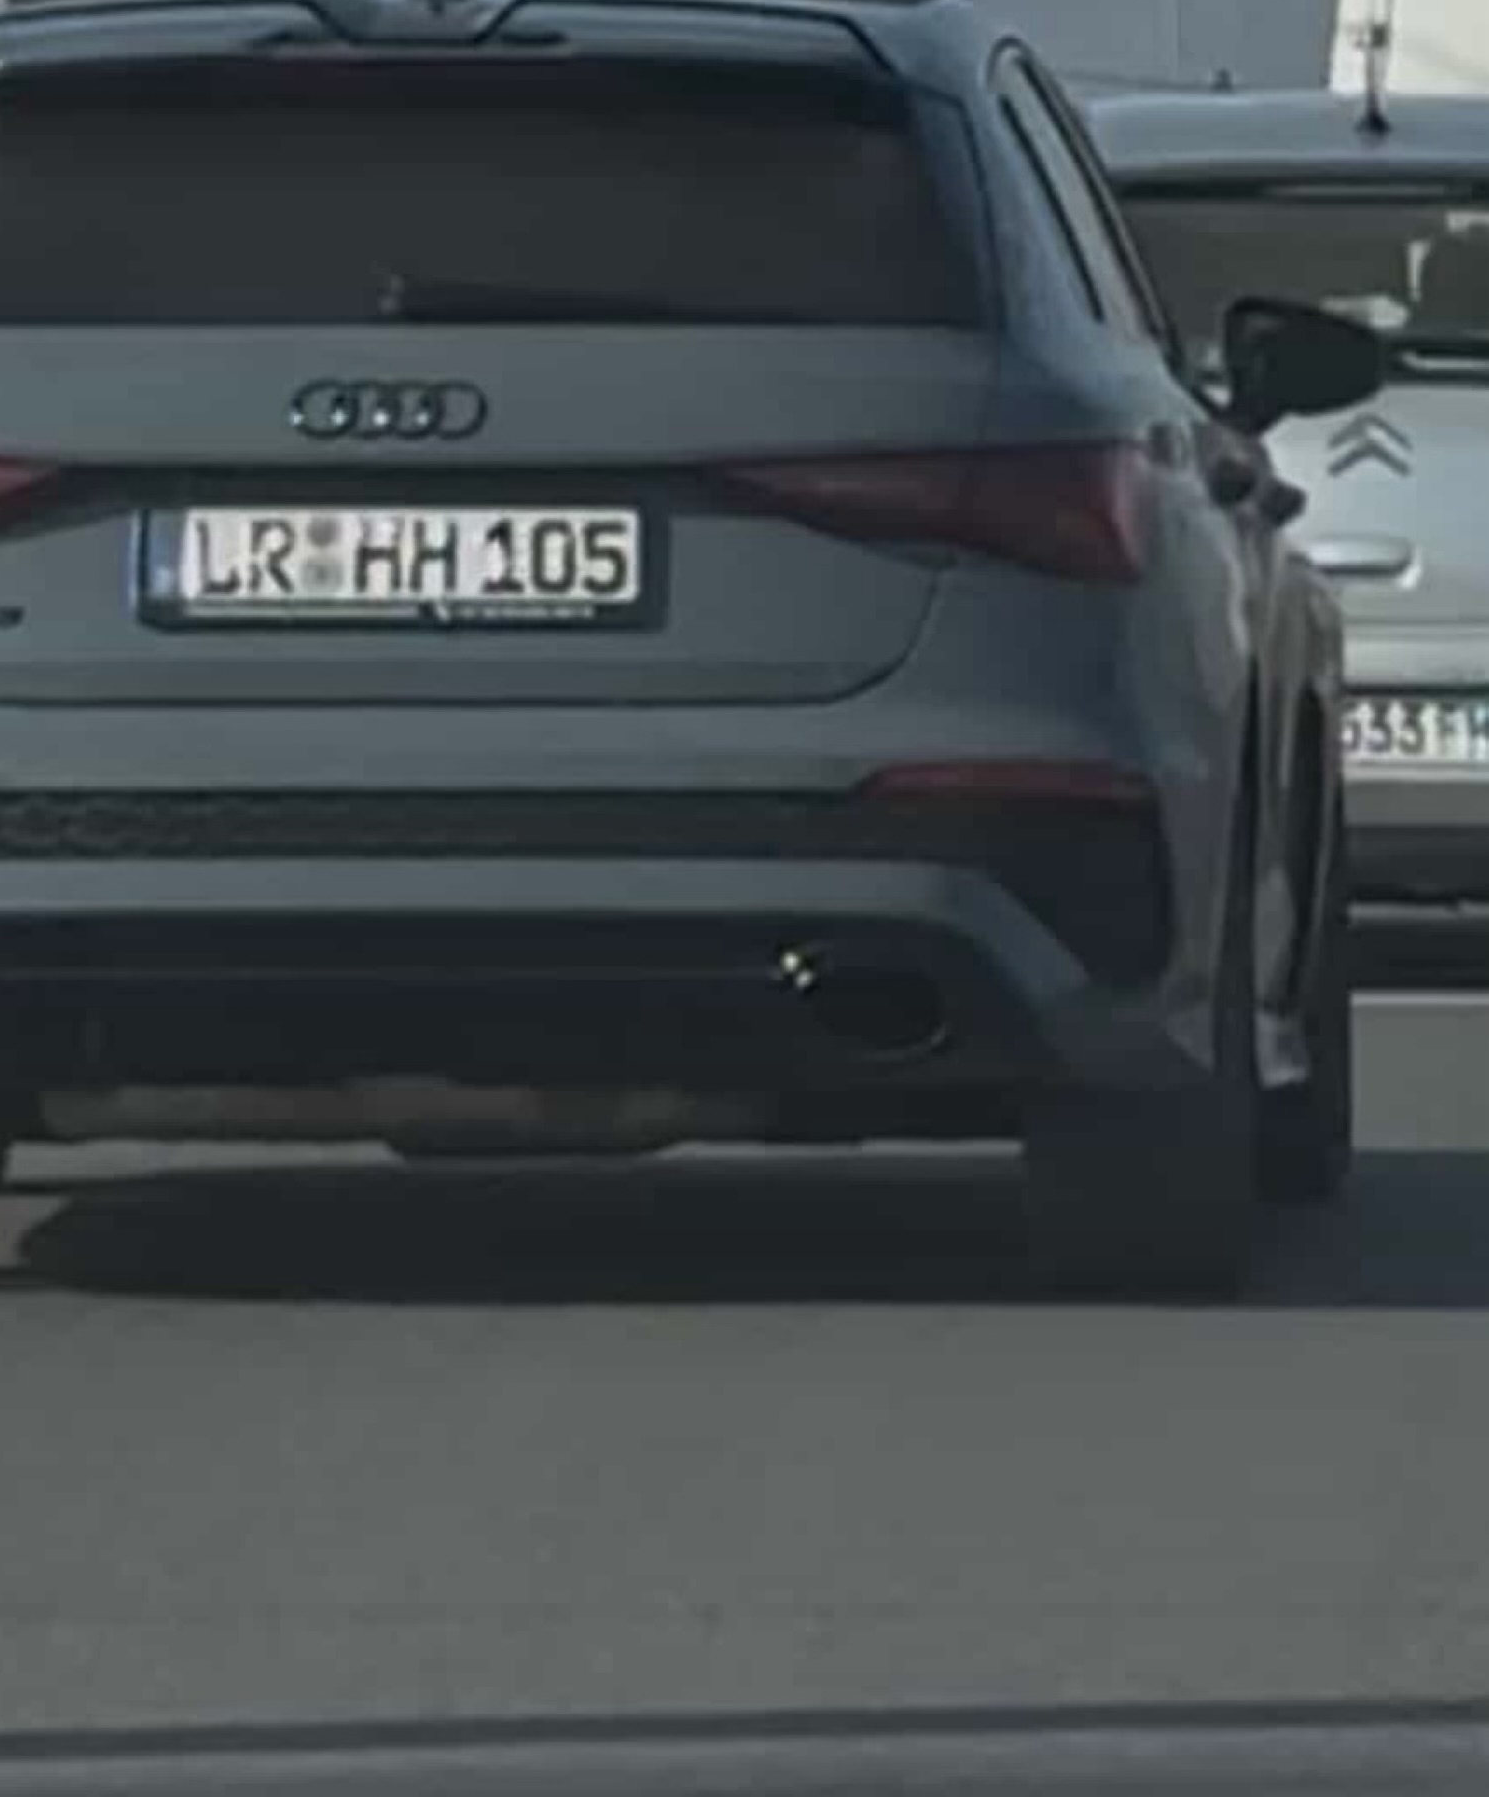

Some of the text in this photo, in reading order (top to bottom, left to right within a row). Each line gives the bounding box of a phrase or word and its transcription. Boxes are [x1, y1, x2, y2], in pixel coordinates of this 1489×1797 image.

[196, 520, 295, 594] LR
[354, 519, 458, 594] HH
[480, 519, 628, 594] 105
